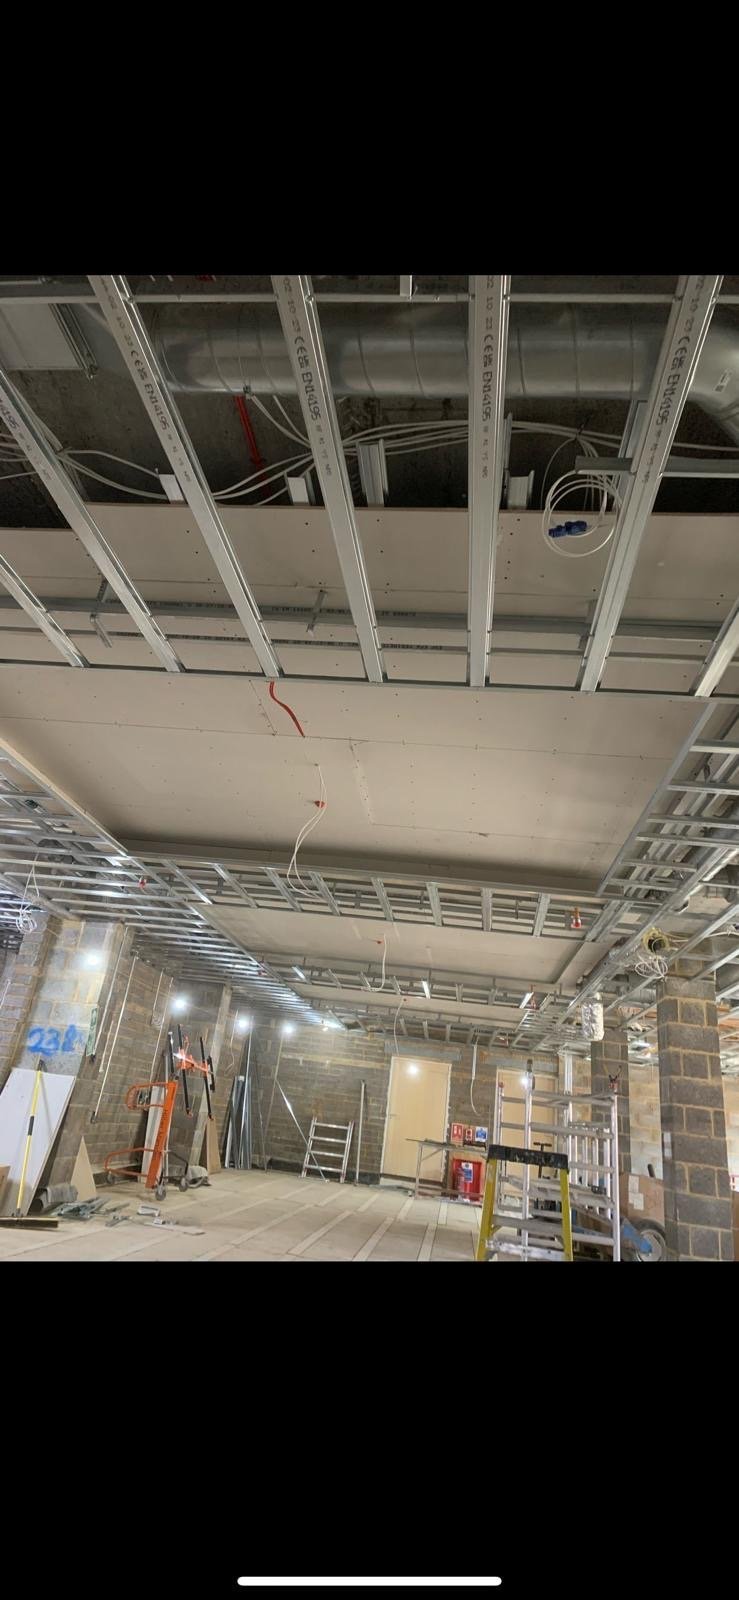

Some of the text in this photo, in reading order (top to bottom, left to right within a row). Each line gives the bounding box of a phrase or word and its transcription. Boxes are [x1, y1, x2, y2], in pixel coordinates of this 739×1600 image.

[145, 383, 170, 431] EN14195
[302, 372, 321, 421] EN14195
[482, 371, 493, 421] EN14195
[656, 374, 680, 426] EN14195
